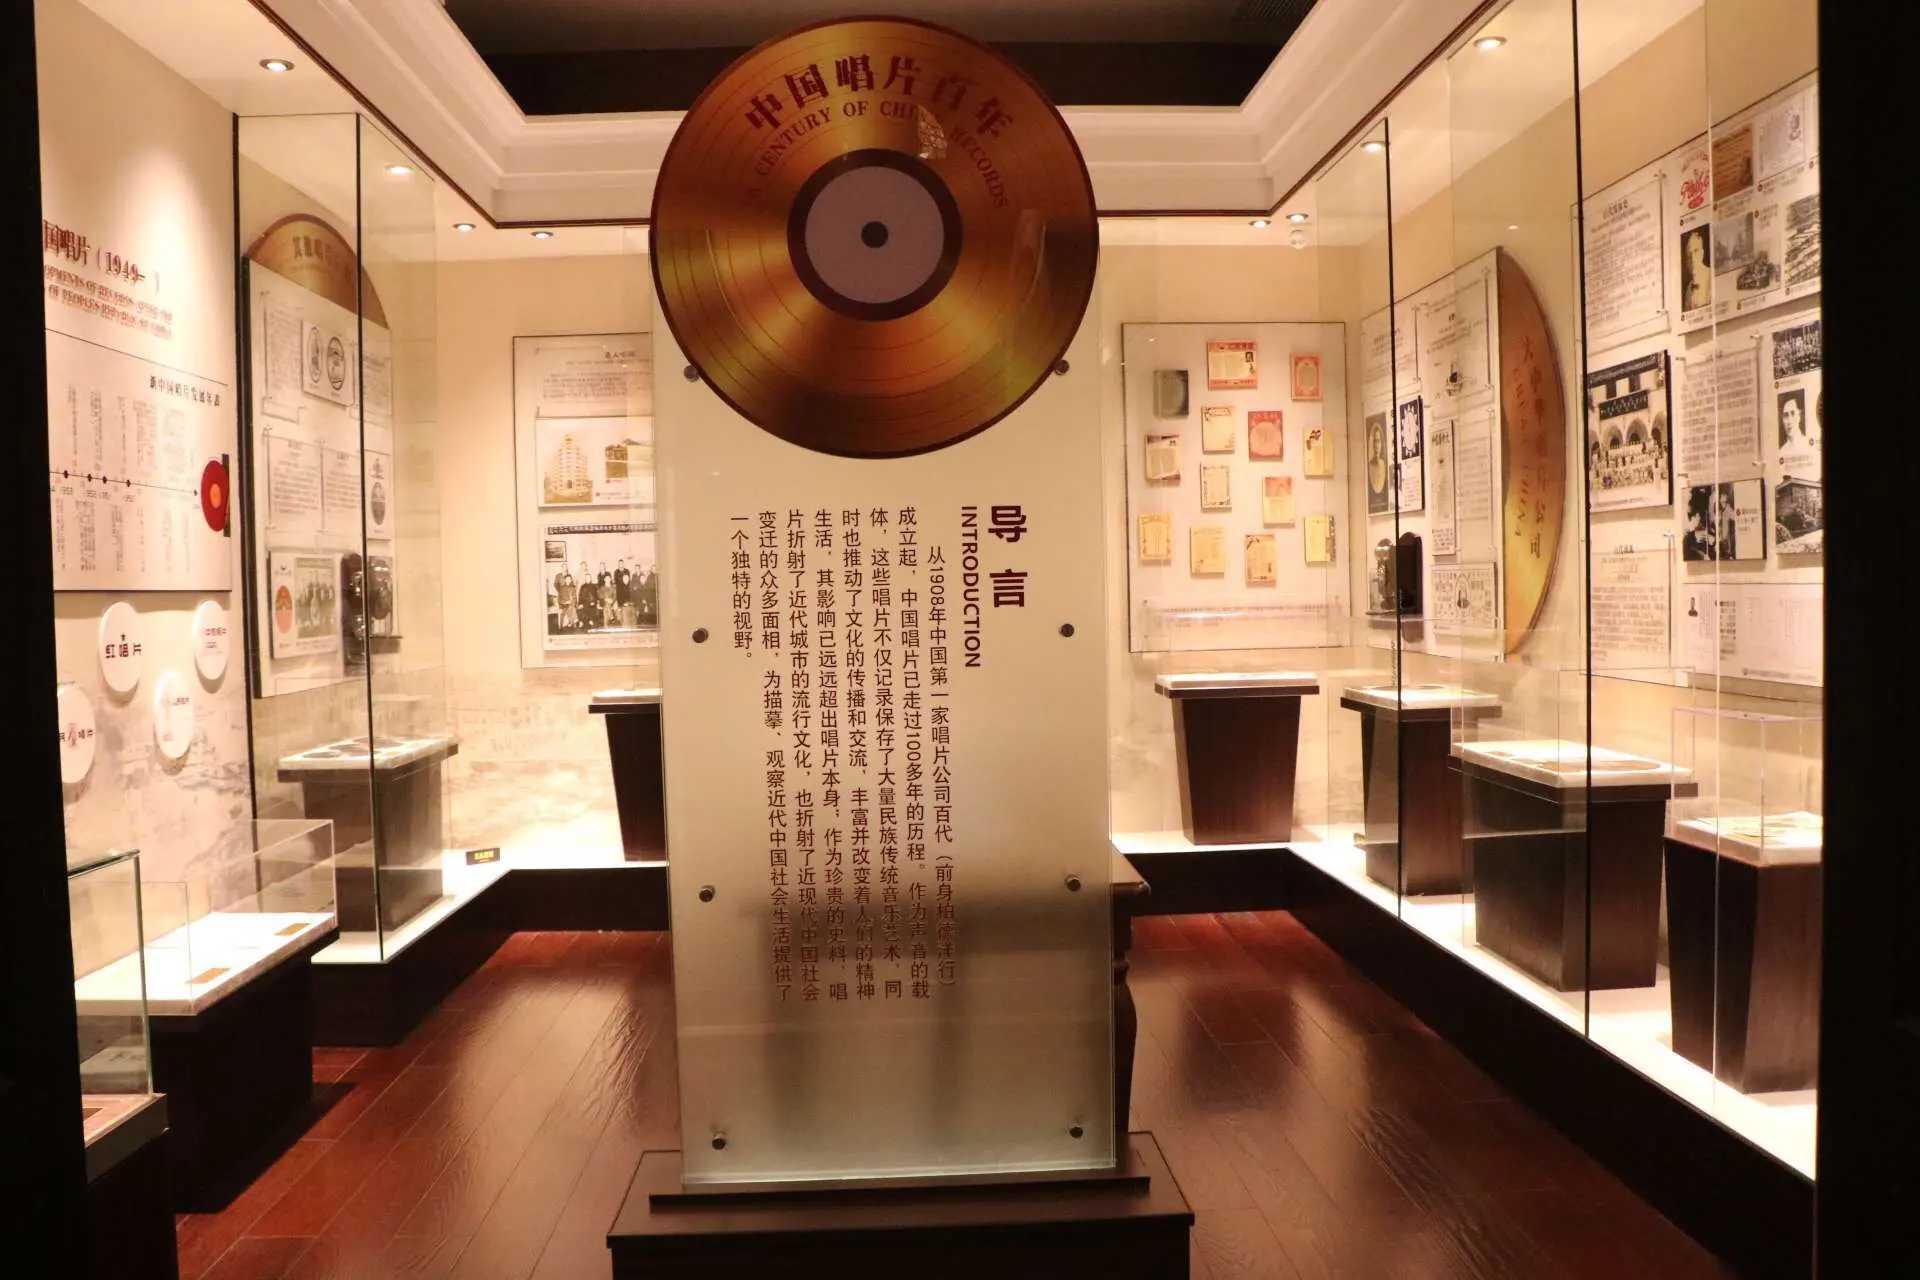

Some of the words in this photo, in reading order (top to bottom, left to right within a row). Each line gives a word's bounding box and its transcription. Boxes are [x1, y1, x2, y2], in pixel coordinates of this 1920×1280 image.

[746, 54, 1014, 142] 中国唱片百年
[756, 107, 833, 177] CENTURY
[843, 101, 869, 118] OF
[951, 126, 1008, 208] RECORDS
[730, 516, 753, 658] 一个独特的视野。
[961, 505, 981, 668] INTRODUCTION
[987, 505, 1028, 608] 导言
